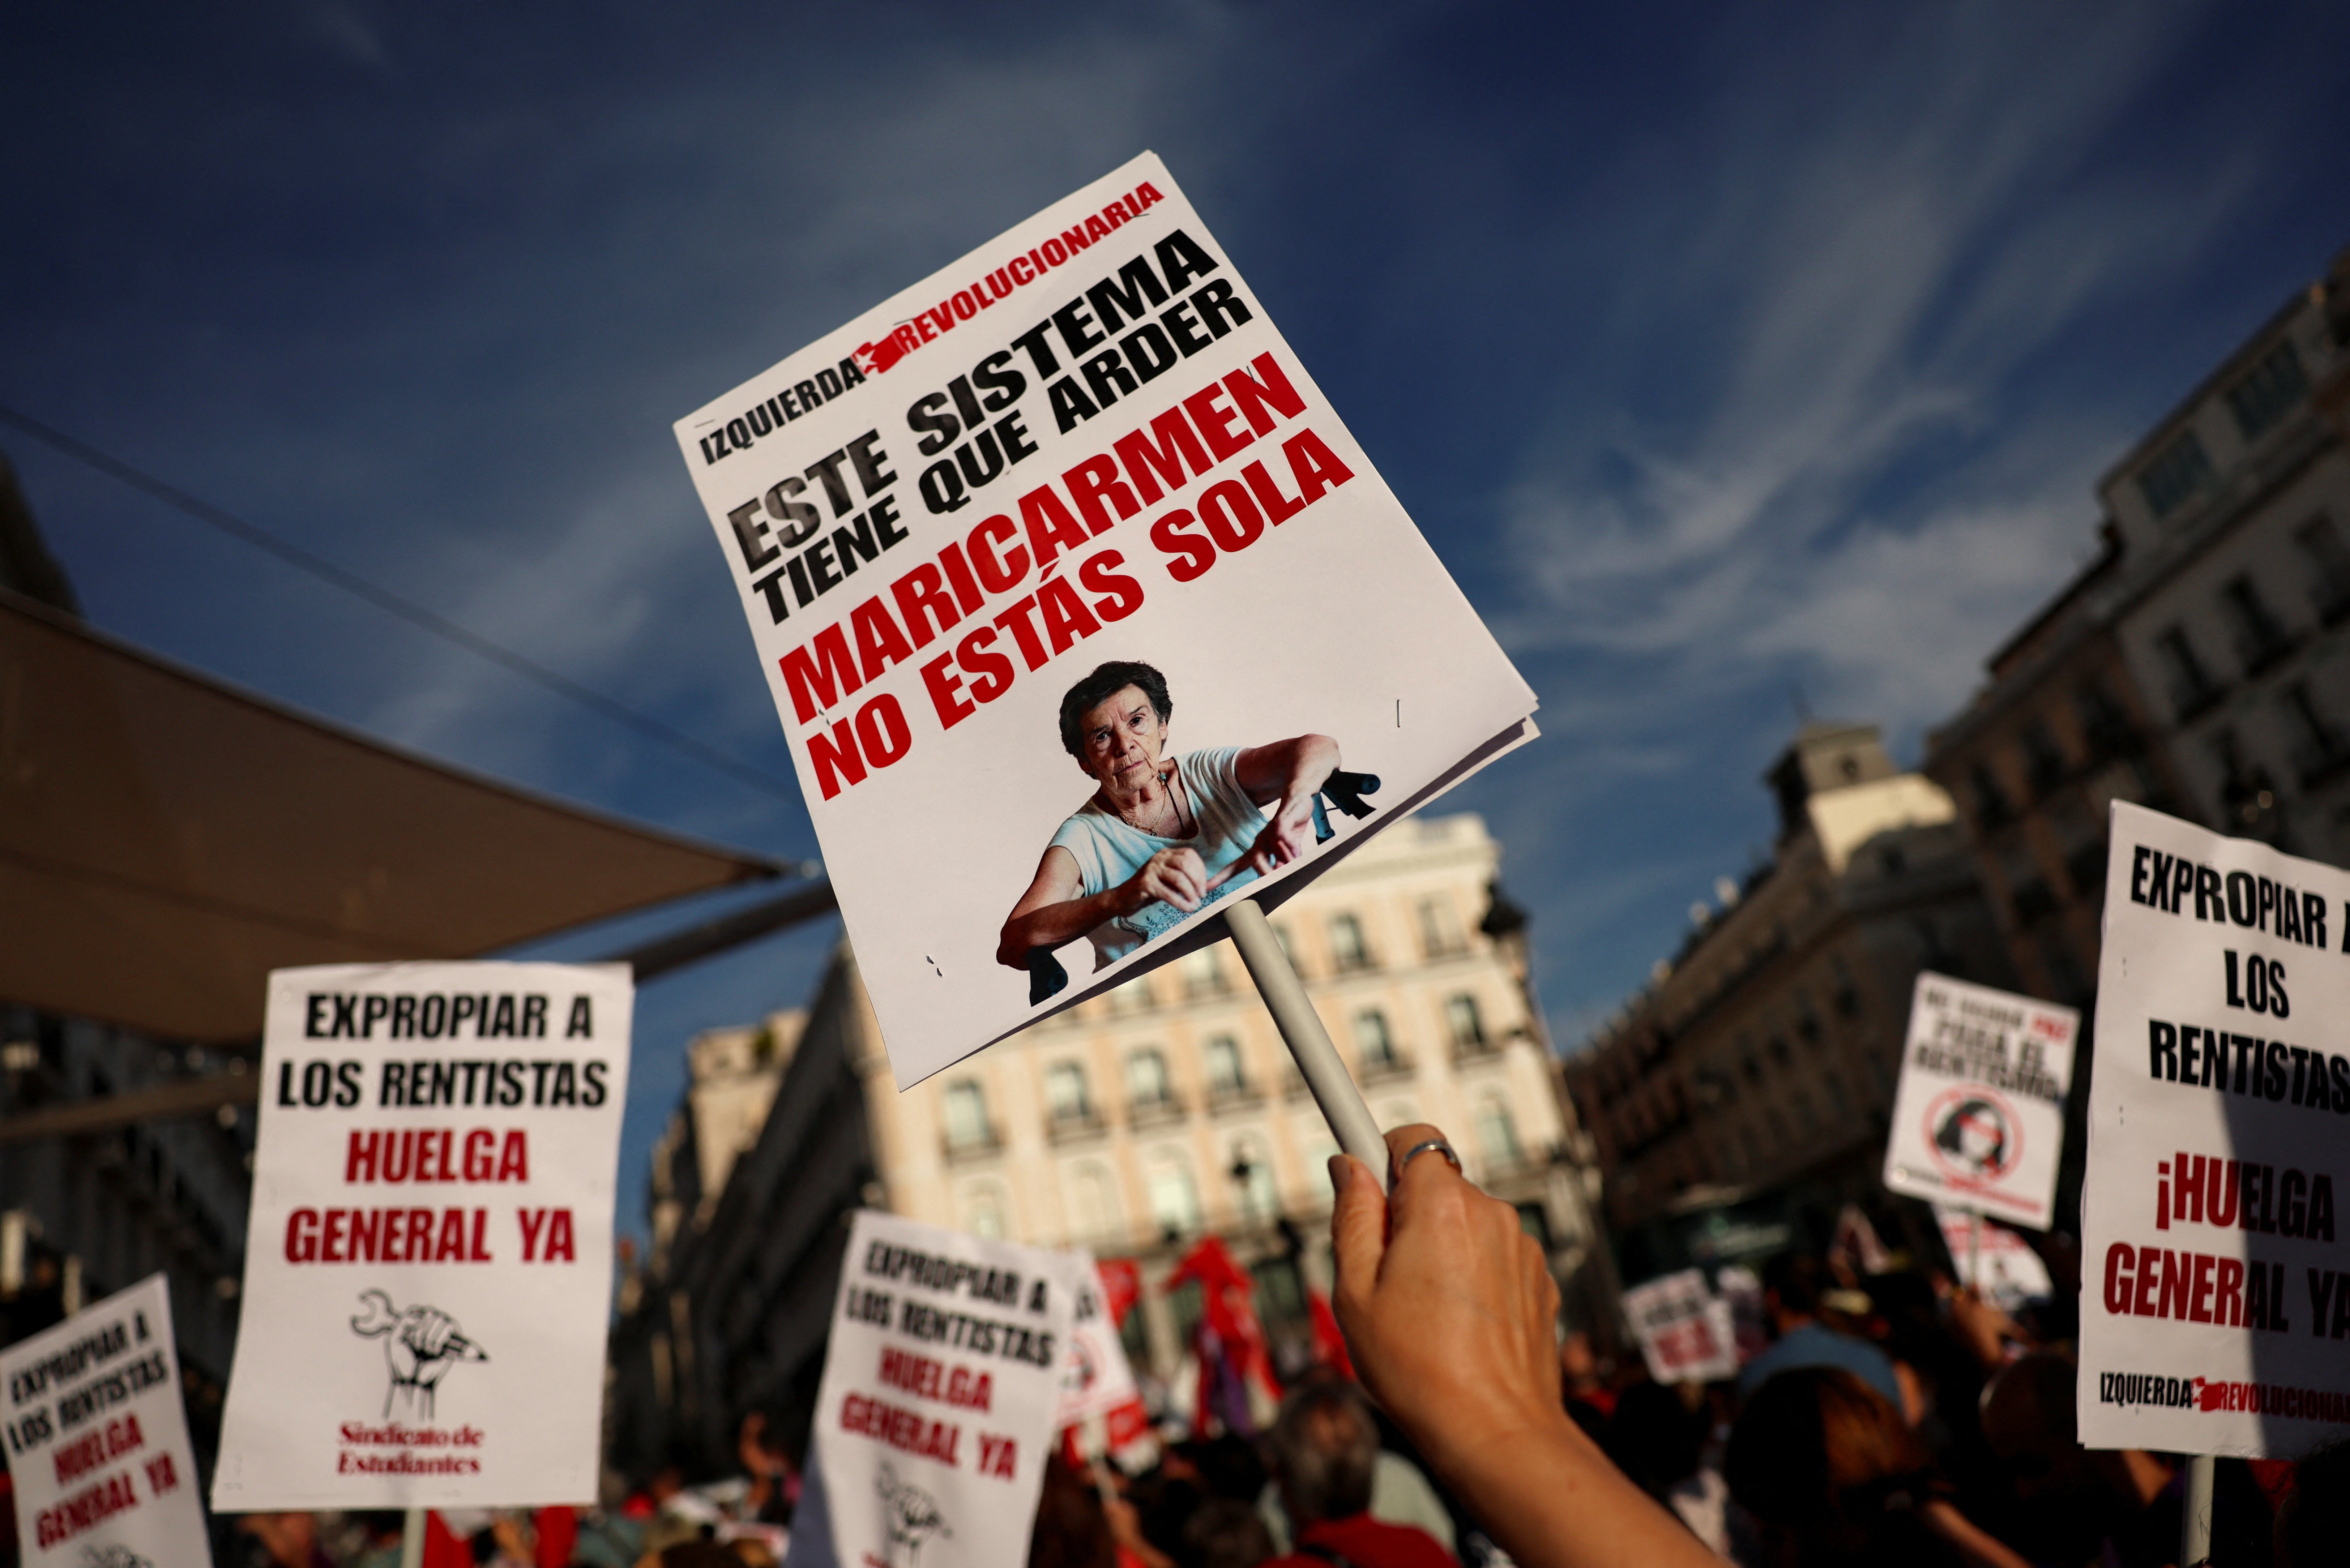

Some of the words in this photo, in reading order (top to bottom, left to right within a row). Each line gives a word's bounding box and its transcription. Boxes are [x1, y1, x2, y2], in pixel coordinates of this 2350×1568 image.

[699, 357, 867, 465] IZQUIERDA
[894, 182, 1164, 354] REVOLUCIONARIA
[727, 429, 898, 574] ESTE
[907, 229, 1219, 457] SISTEMA
[753, 494, 909, 626] TIENE
[919, 410, 1039, 514] QUE
[1046, 277, 1253, 434] ARDER
[778, 351, 1307, 725] MARICARMEN
[806, 693, 911, 801] NO
[919, 549, 1145, 731] ESTÁS
[1150, 428, 1355, 582] SOLA
[2131, 844, 2327, 950] EXPROPIAR
[304, 992, 549, 1040] EXPROPIAR
[566, 995, 592, 1038] A
[2223, 948, 2290, 1020] LOS
[277, 1060, 362, 1108] LOS
[379, 1060, 608, 1108] RENTISTAS
[2149, 1018, 2350, 1113] RENTISTAS
[344, 1129, 528, 1183] HUELGA
[2155, 1151, 2334, 1242] ¡HUELGA
[284, 1208, 492, 1264] GENERAL
[517, 1209, 576, 1263] YA
[865, 1241, 1020, 1307] EXPROPIAR
[1028, 1279, 1049, 1314] A
[847, 1287, 892, 1326] LOS
[900, 1301, 1056, 1367] RENTISTAS
[2103, 1241, 2289, 1332] GENERAL
[2307, 1267, 2350, 1340] YA
[6, 1406, 53, 1454] LOS
[58, 1351, 167, 1427] RENTISTAS
[11, 1322, 127, 1404] EXPROPIAR
[134, 1311, 149, 1340] A
[878, 1346, 993, 1415] HUELGA
[2101, 1371, 2192, 1409] IZQUIERDA
[53, 1411, 143, 1486] HUELGA
[337, 1451, 482, 1476] Estudiantes
[338, 1421, 444, 1447] Sindicato
[446, 1423, 484, 1447] de
[840, 1392, 962, 1467] GENERAL
[976, 1431, 1018, 1482] YA
[36, 1471, 138, 1551] GENERAL
[145, 1453, 179, 1496] YA
